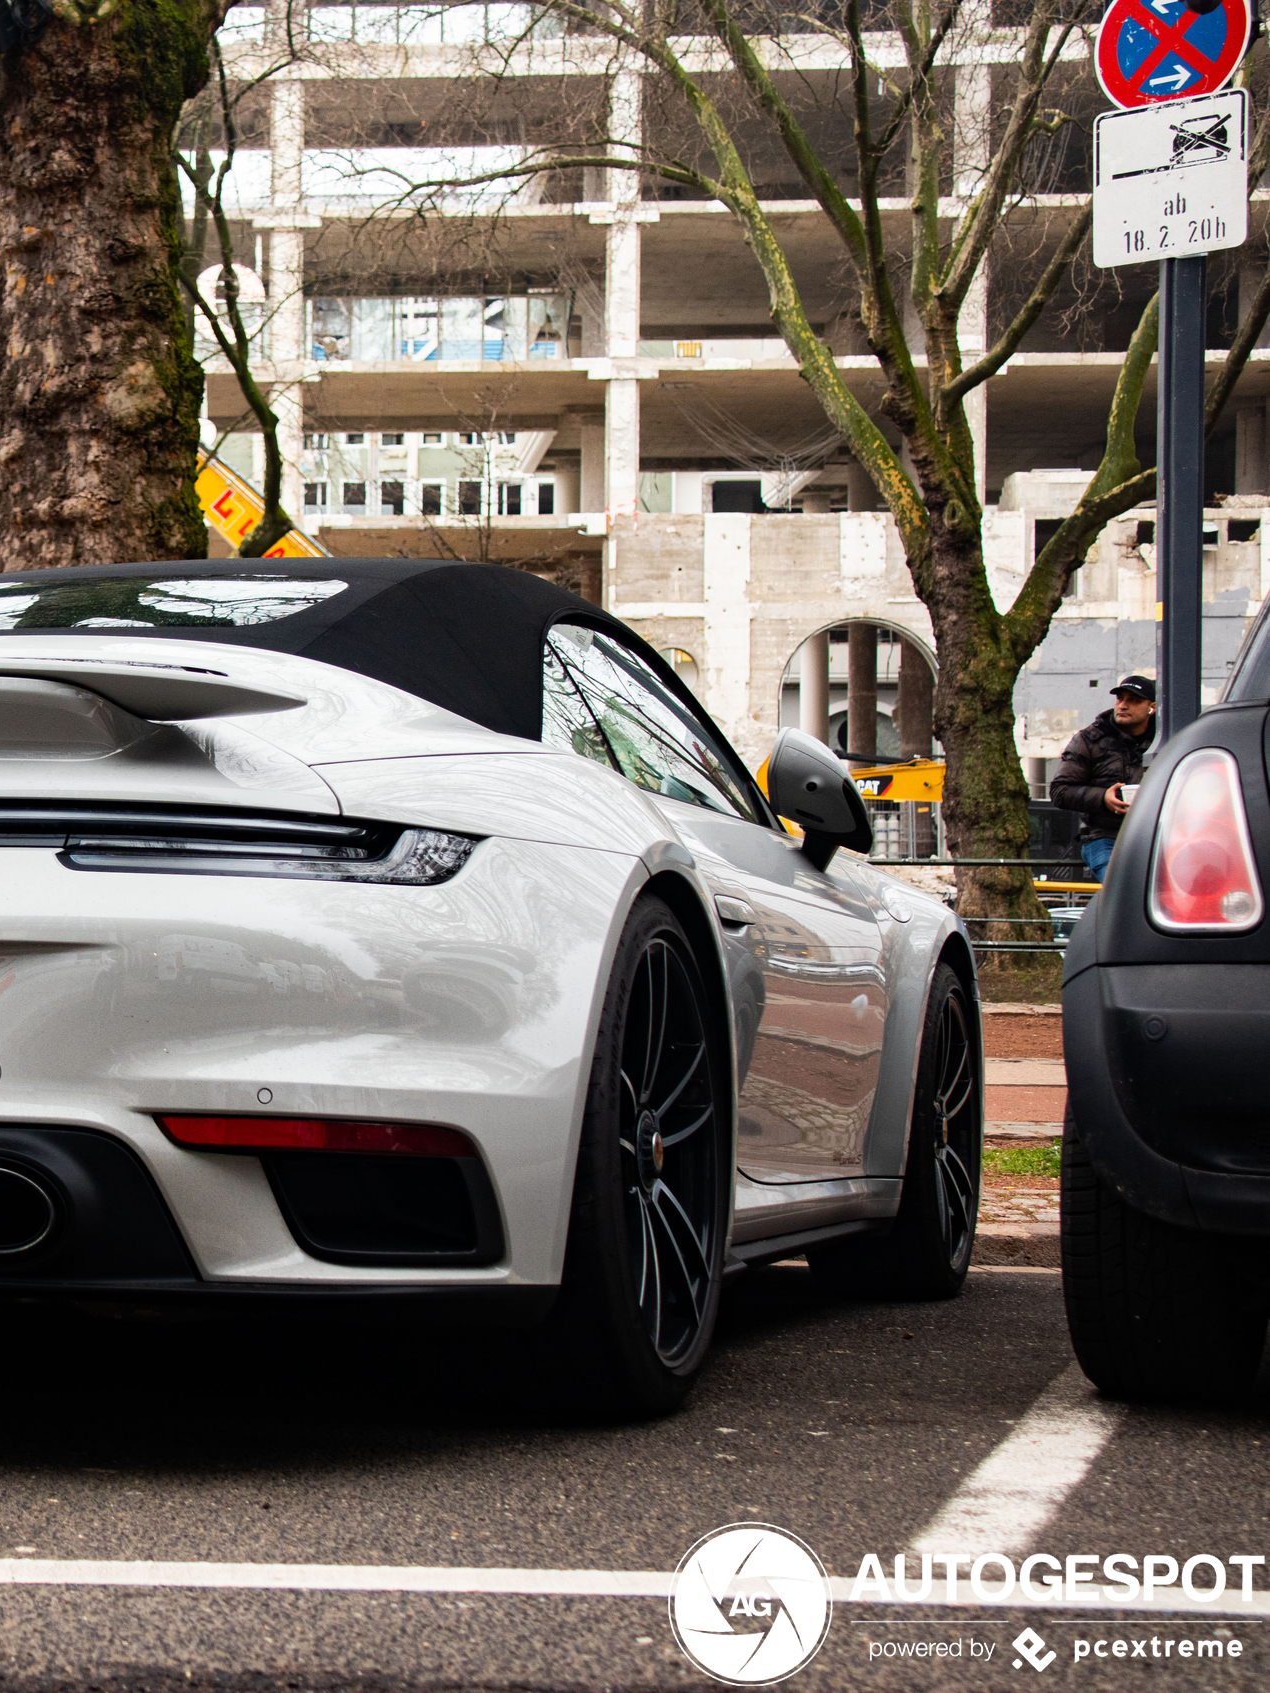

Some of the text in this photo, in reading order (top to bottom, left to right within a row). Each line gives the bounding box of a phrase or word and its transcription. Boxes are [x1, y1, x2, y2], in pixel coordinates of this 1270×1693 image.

[1164, 192, 1186, 216] ab
[1188, 216, 1226, 243] 20h
[856, 779, 880, 796] CAT
